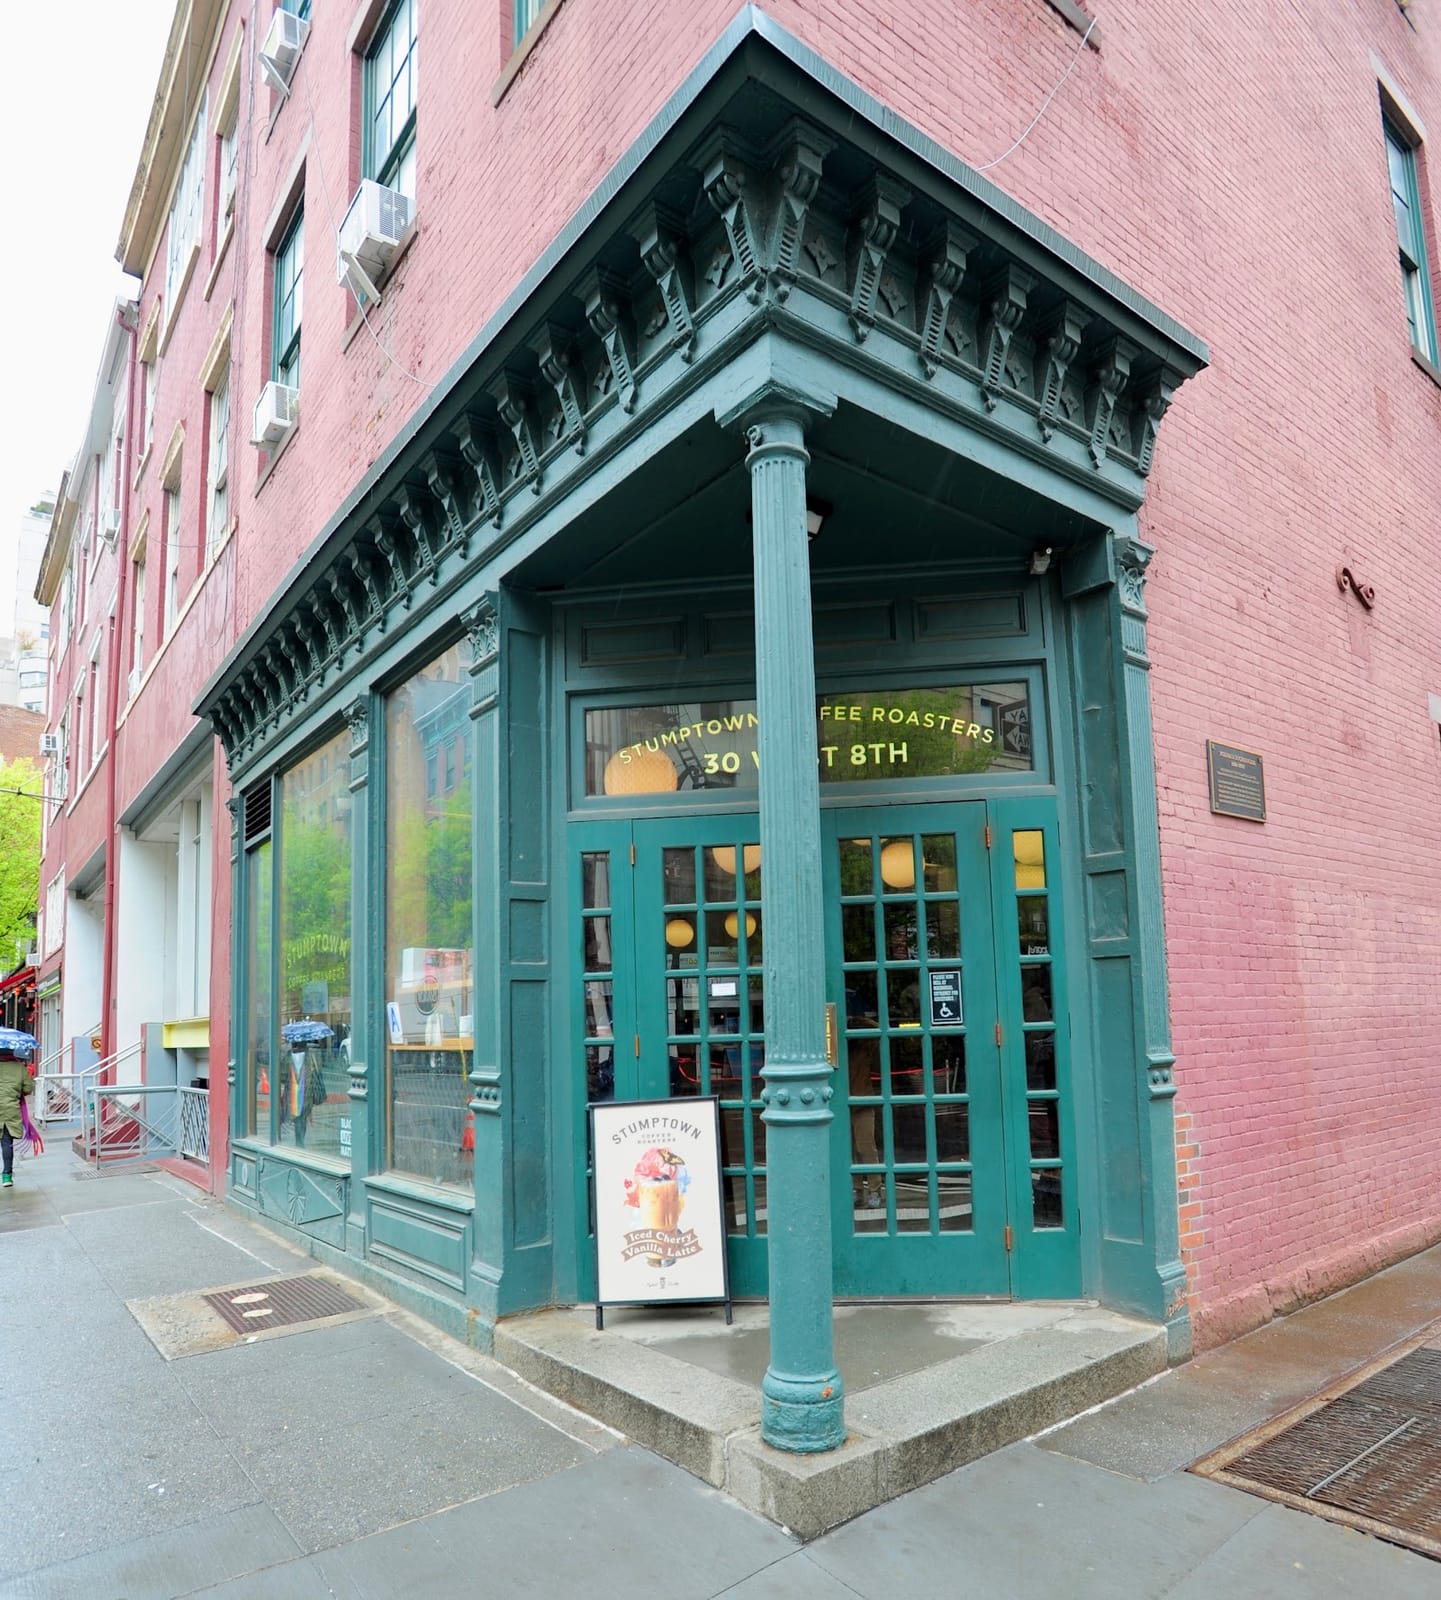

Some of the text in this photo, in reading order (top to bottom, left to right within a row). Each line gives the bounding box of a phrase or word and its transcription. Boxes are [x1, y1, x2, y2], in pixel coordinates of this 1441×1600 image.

[618, 712, 759, 764] STUMPTOWN
[872, 707, 995, 744] ROASTERS
[704, 752, 740, 774] 30
[850, 741, 908, 766] 8TH
[286, 933, 347, 968] STUMPTOWN
[612, 1117, 702, 1145] STUMPTOWN
[625, 1243, 697, 1258] Vanilla Latte
[628, 1229, 692, 1245] Iced Cherry
